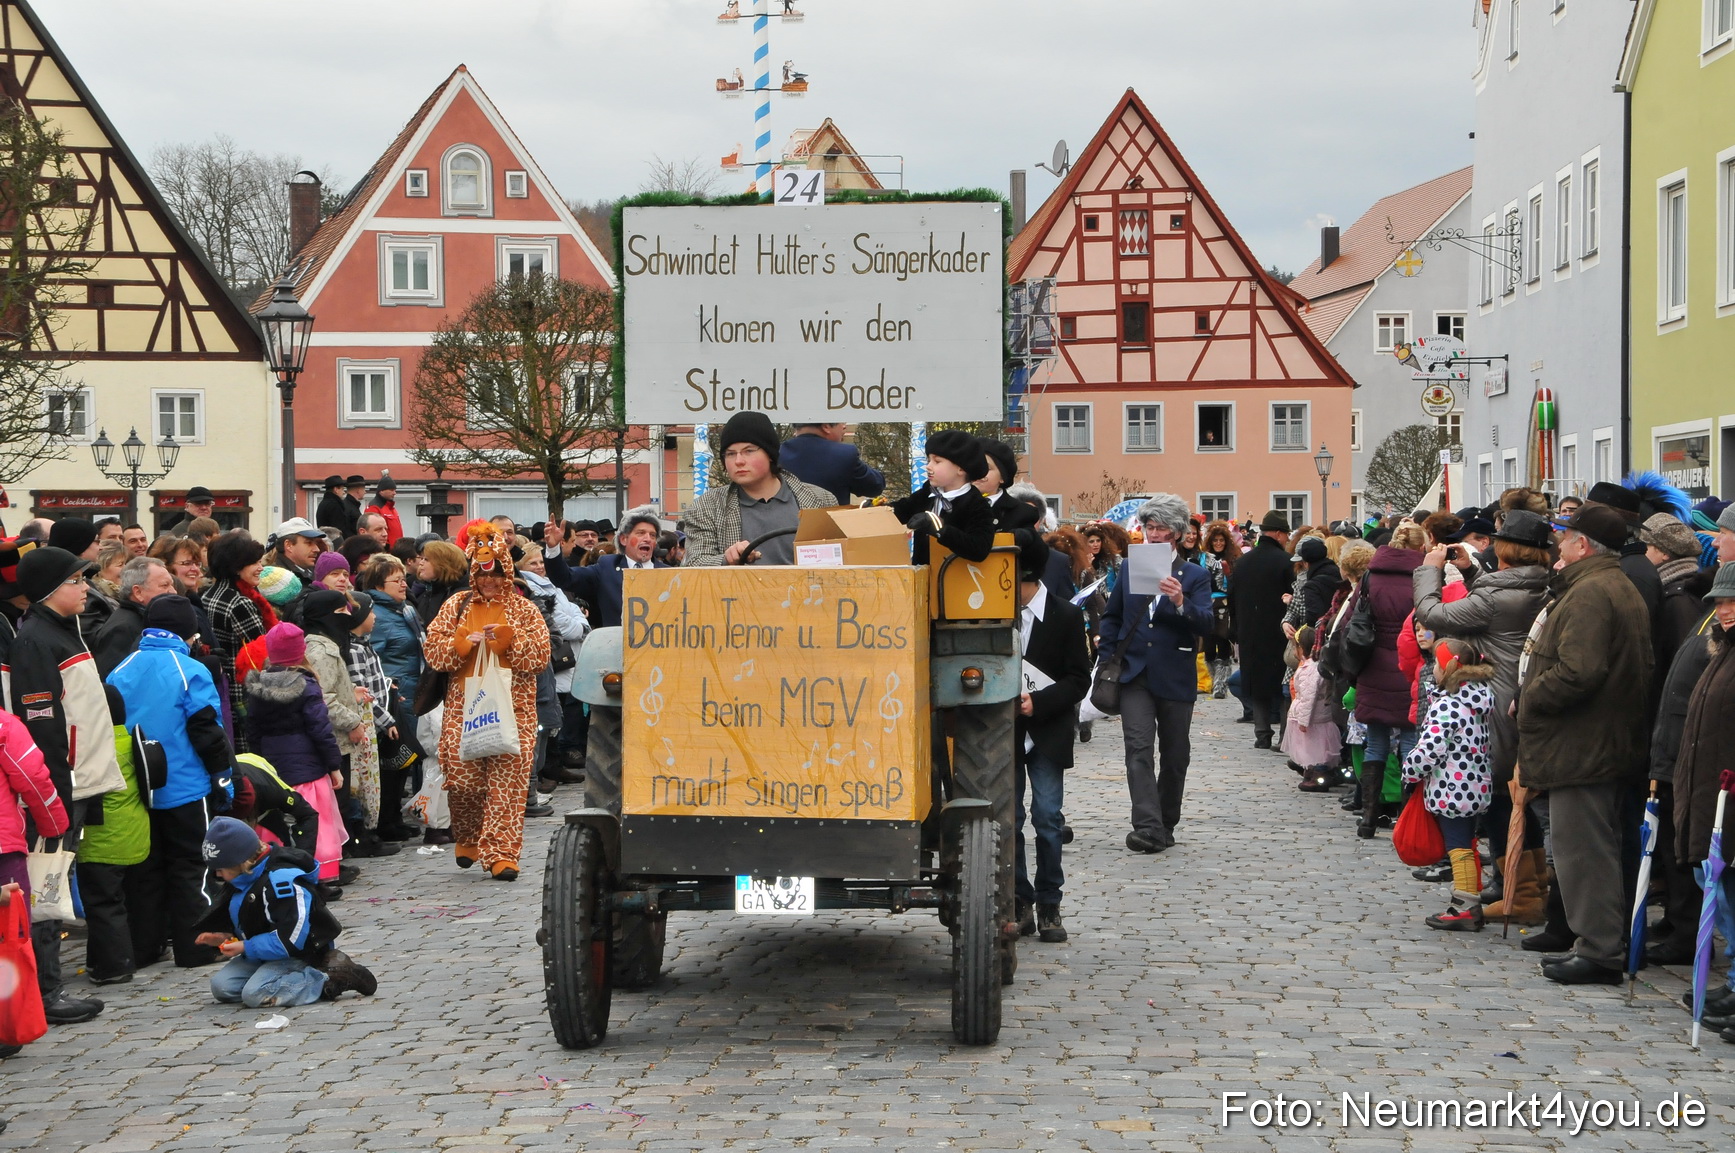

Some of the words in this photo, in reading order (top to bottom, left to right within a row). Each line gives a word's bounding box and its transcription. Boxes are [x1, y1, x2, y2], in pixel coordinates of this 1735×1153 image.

[778, 172, 820, 203] 24
[625, 234, 739, 276] Schwindet
[757, 233, 836, 276] Hutter's
[852, 232, 991, 281] Sängerkader
[699, 304, 775, 344] klonen
[800, 310, 842, 343] wir
[866, 303, 912, 342] den
[683, 367, 789, 412] Steindl
[826, 367, 916, 411] Bader
[1662, 468, 1702, 488] HOFBAUER
[1704, 466, 1710, 487] &
[62, 496, 106, 506] Cocktailbar
[721, 597, 783, 649] Tenor
[798, 626, 821, 649] u.
[837, 598, 907, 650] Bass
[701, 677, 762, 728] beim
[780, 676, 866, 728] MGV
[651, 757, 731, 807] macht
[746, 771, 828, 814] singen
[839, 766, 904, 816] spaß
[742, 894, 765, 910] GA
